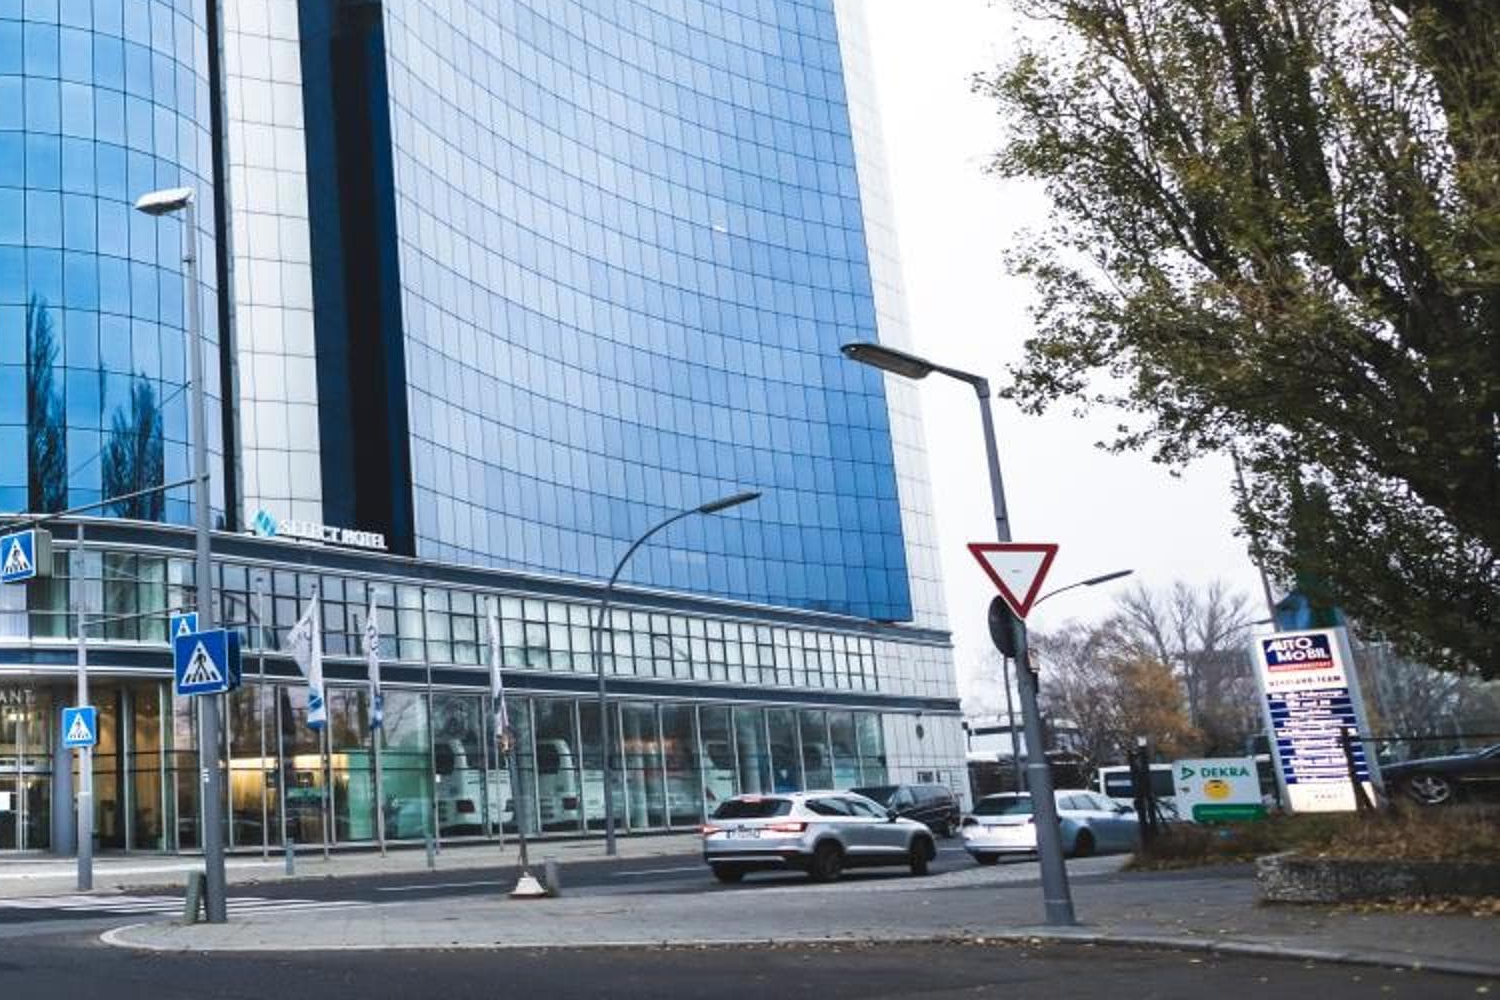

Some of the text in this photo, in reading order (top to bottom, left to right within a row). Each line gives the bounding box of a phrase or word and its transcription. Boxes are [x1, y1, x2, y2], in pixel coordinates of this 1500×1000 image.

[280, 519, 388, 549] SELECT HOTEL
[1267, 638, 1313, 652] AUTO
[1276, 648, 1330, 663] MOBIL
[1200, 766, 1250, 777] DEKRA
